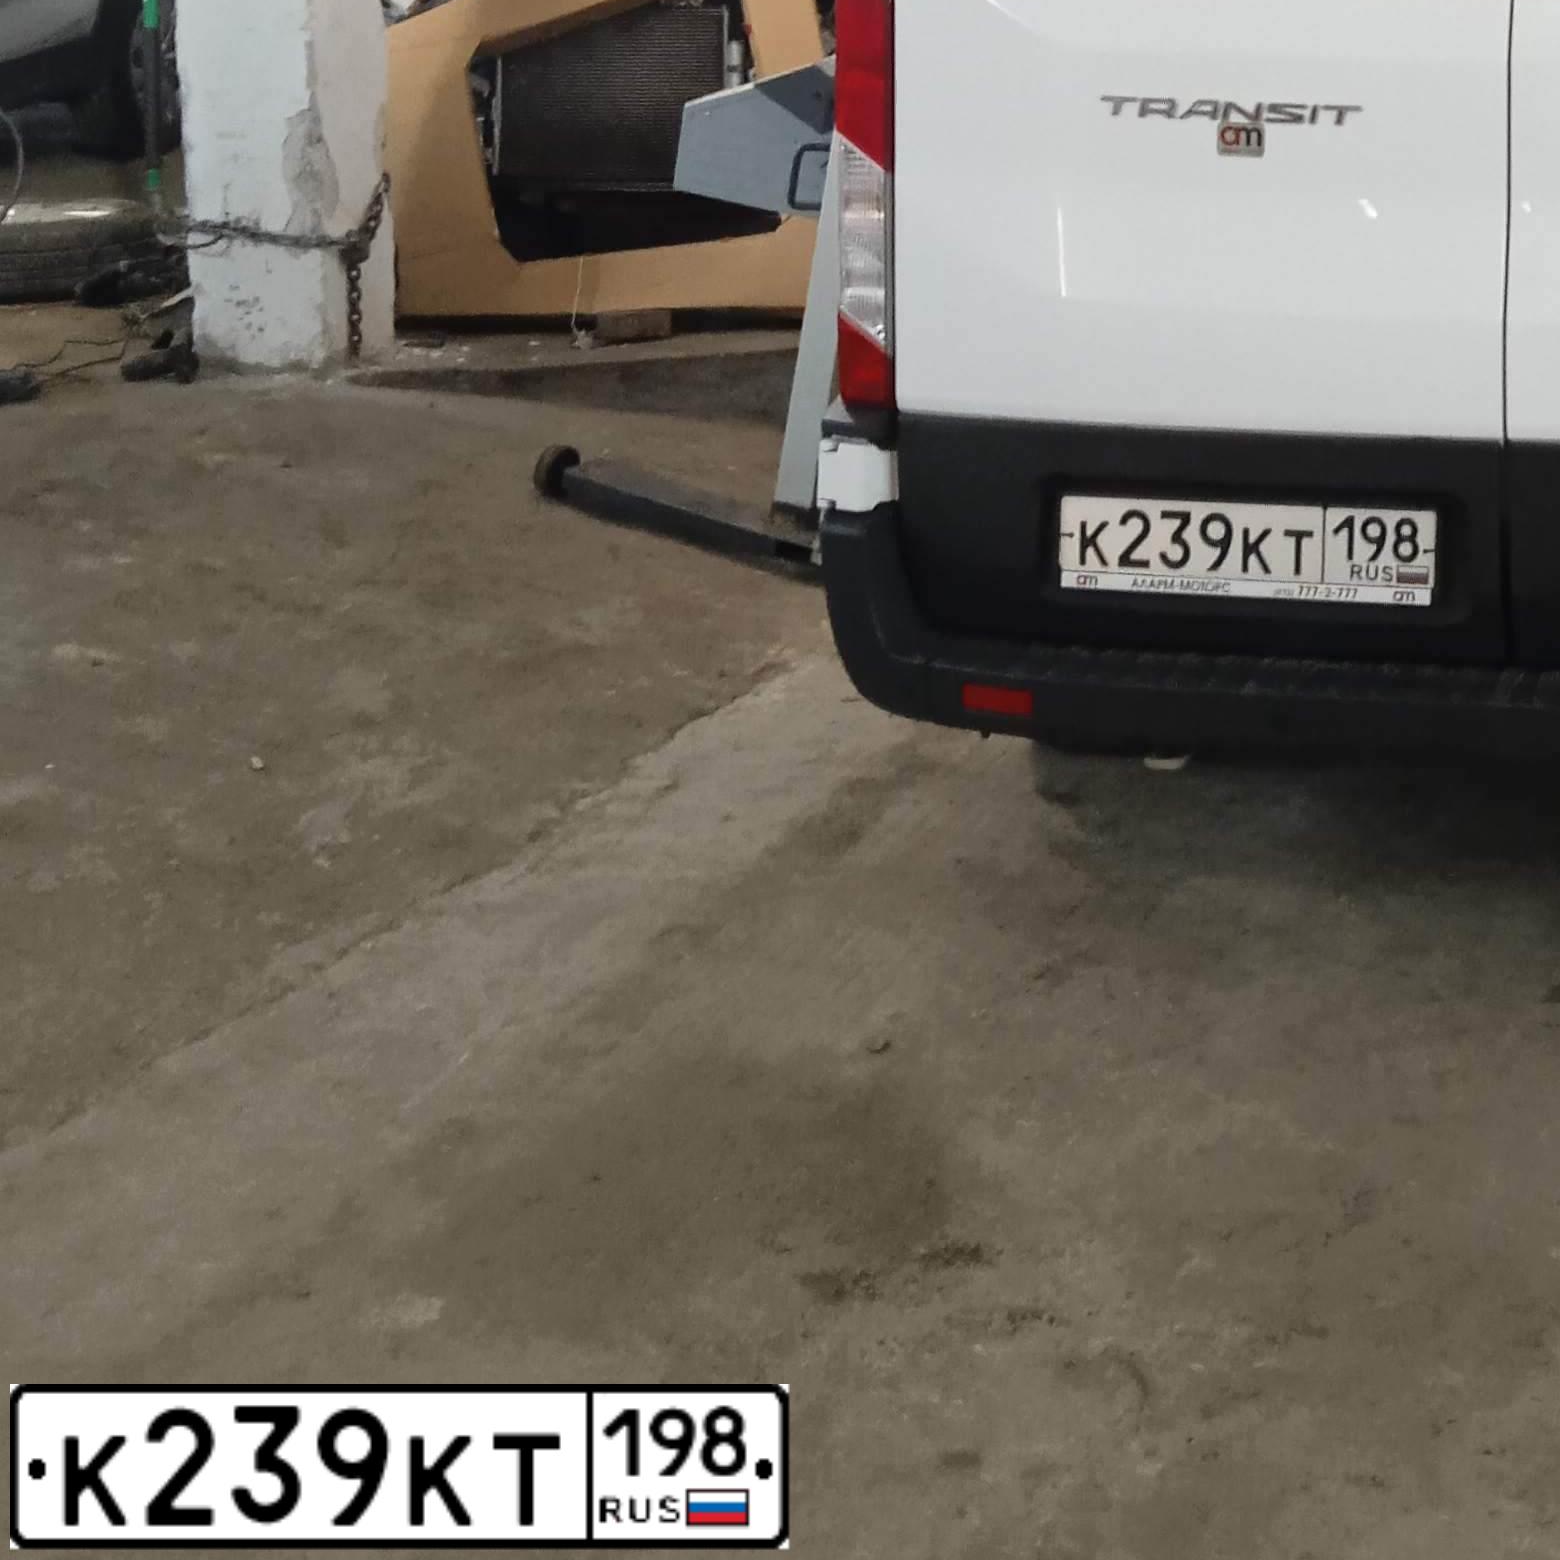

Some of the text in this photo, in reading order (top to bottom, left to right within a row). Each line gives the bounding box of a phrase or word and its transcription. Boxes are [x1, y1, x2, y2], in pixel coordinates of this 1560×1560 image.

[1100, 95, 1363, 126] TRANSIT
[1332, 515, 1420, 563] 198
[1350, 564, 1394, 583] RUS
